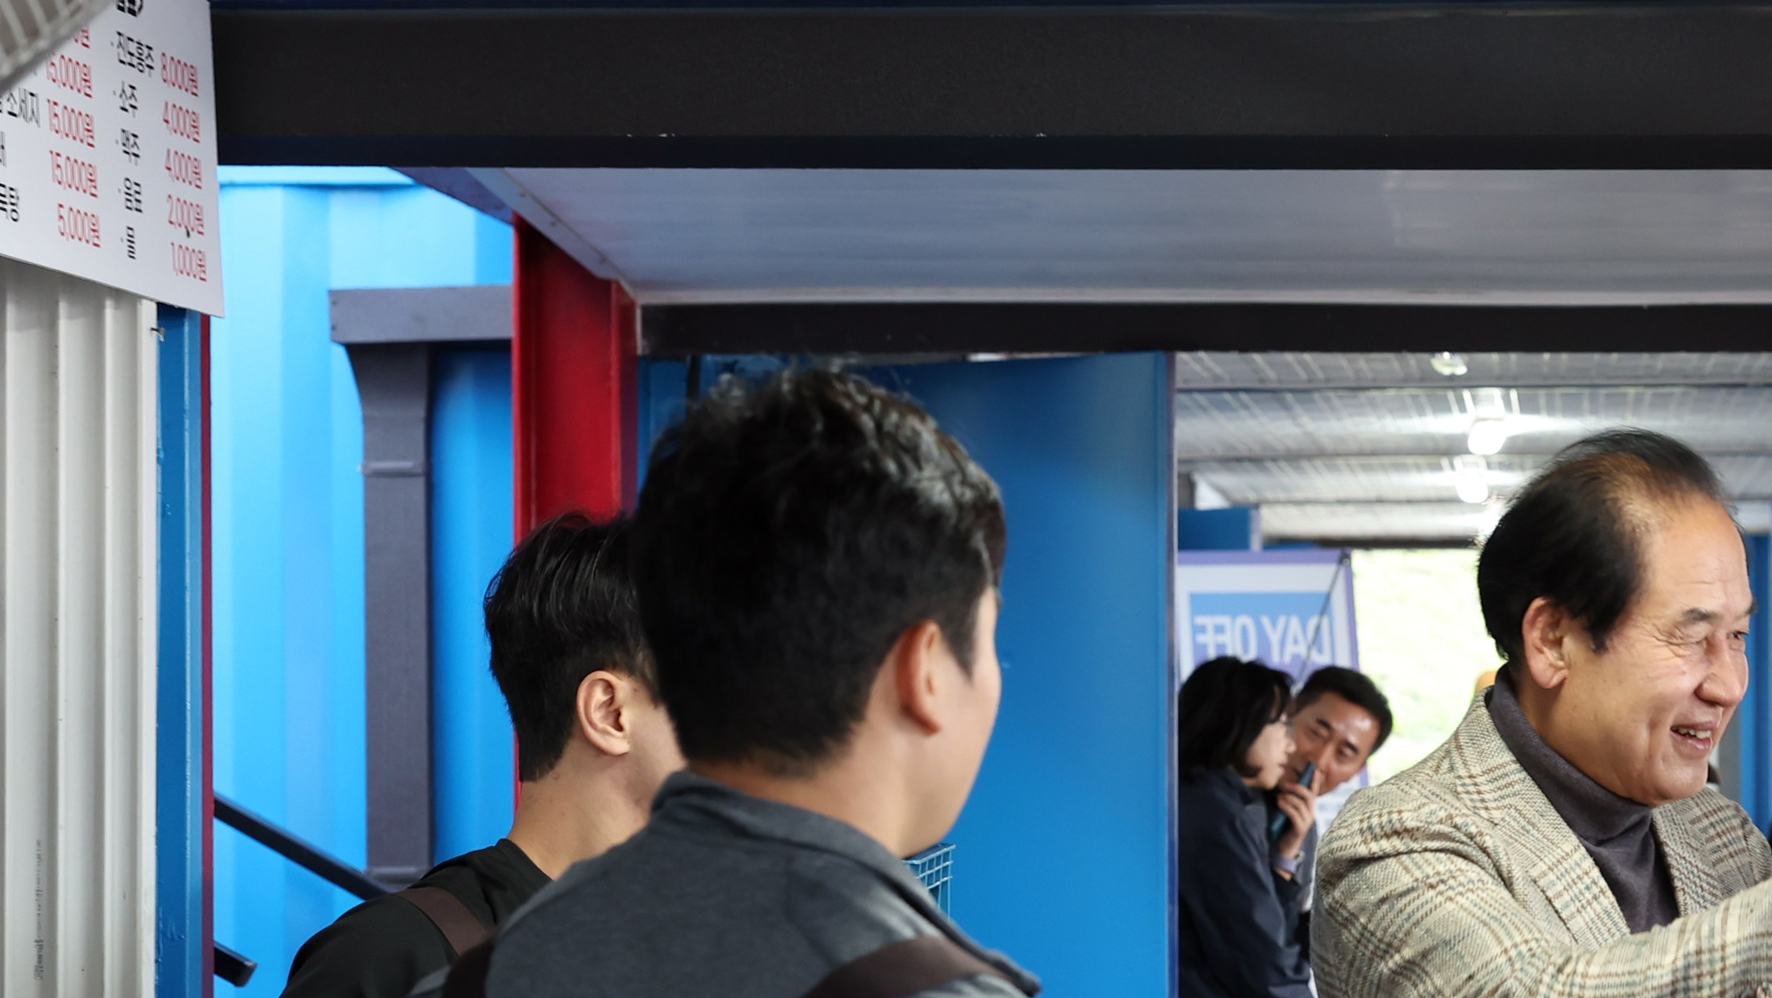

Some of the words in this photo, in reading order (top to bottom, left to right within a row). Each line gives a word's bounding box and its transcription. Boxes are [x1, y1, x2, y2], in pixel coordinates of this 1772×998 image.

[116, 31, 154, 77] 진도홍주
[161, 52, 199, 97] 8,000원
[47, 98, 95, 148] 15,000원
[119, 81, 138, 118] 소주
[163, 101, 200, 143] 4,000원
[49, 149, 98, 198] 15,000원
[120, 128, 140, 166] 맥주
[164, 148, 202, 189] 4,000원
[57, 202, 101, 248] 5,000원
[124, 177, 143, 213] 음료
[166, 193, 204, 235] 2,000원
[126, 225, 136, 260] 물
[170, 241, 207, 282] 1,000원
